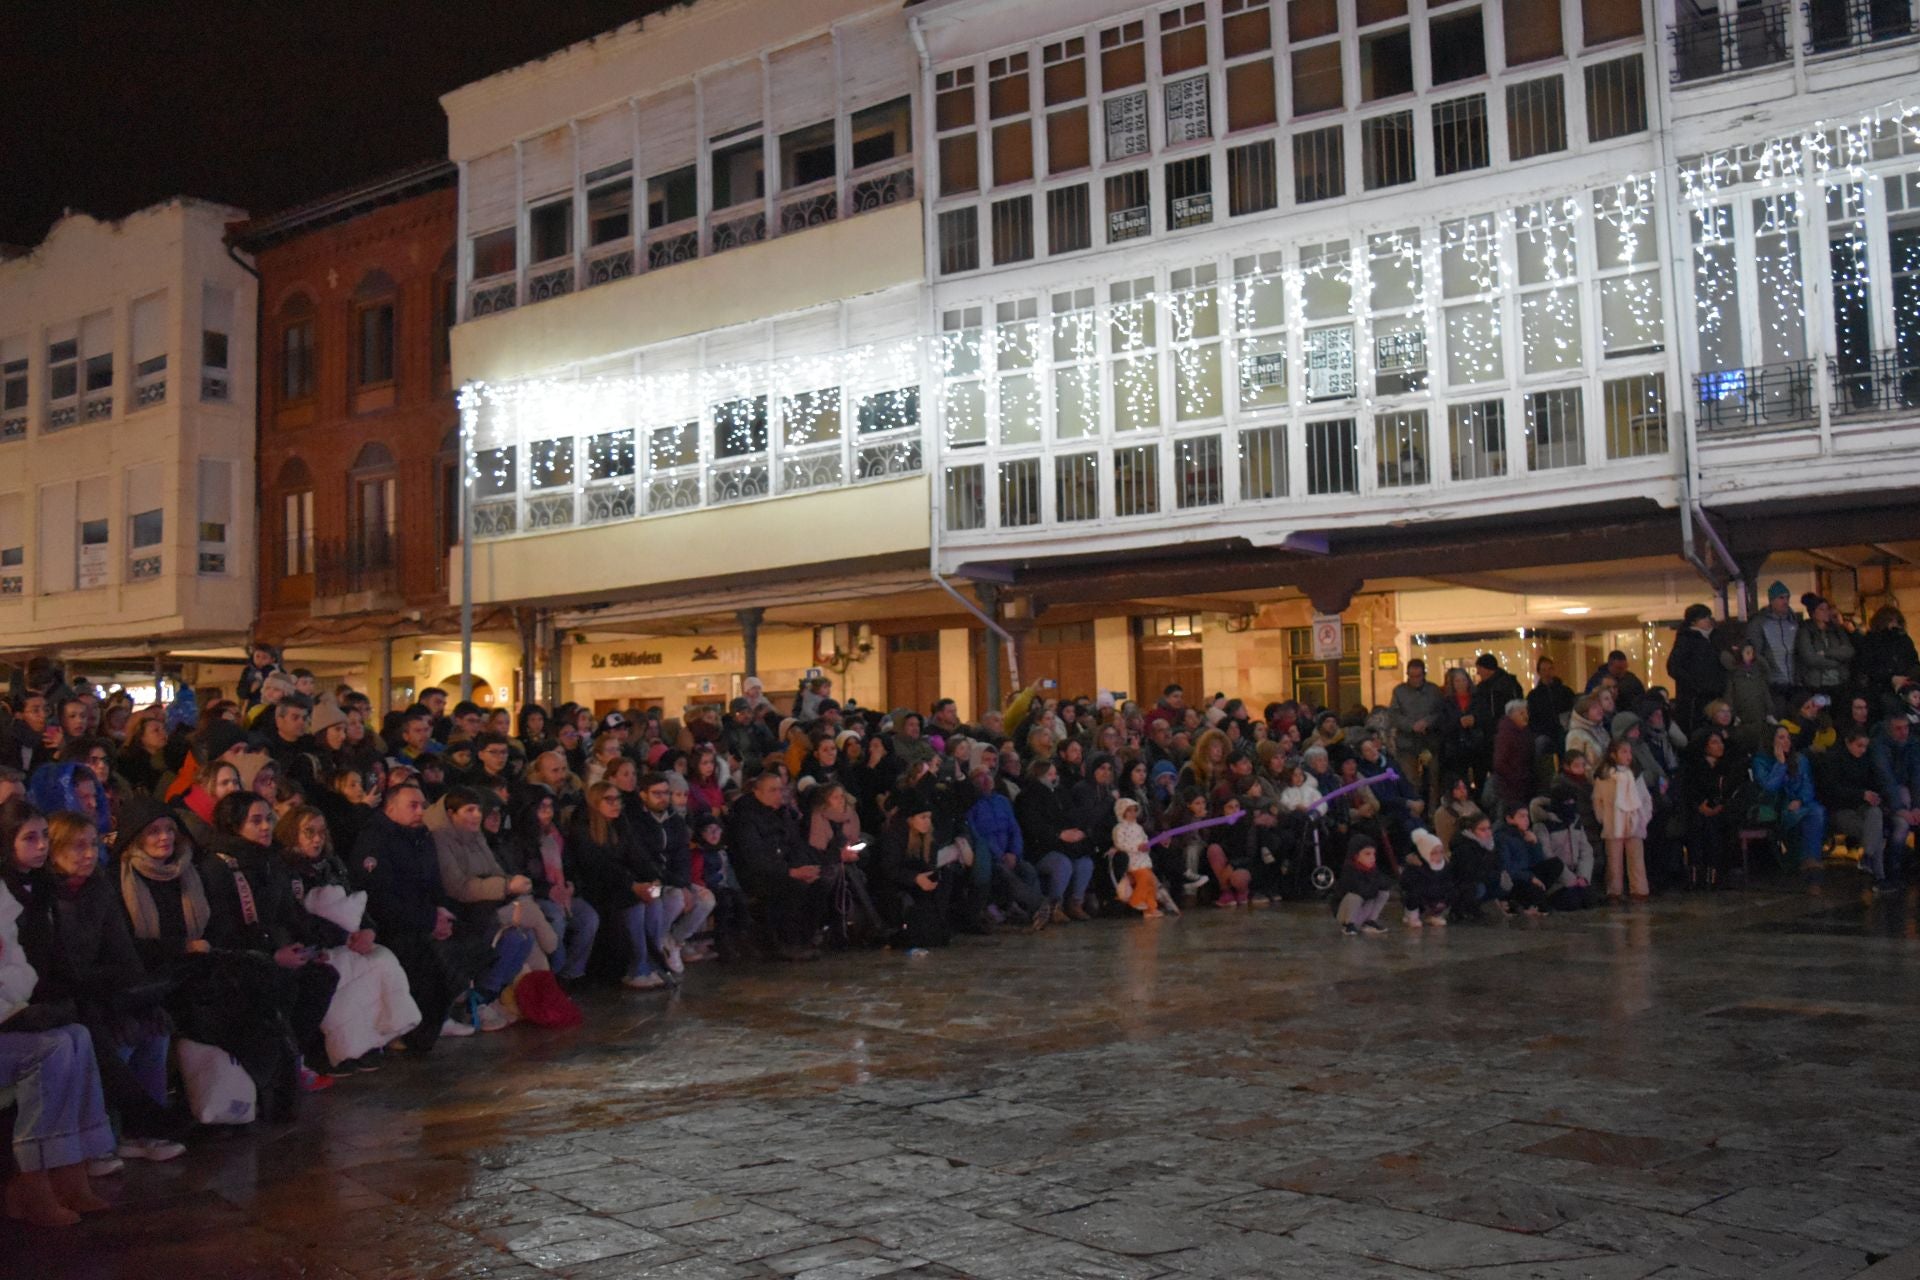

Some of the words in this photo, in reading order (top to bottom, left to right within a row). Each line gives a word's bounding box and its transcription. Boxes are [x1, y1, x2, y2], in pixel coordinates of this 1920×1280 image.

[1183, 81, 1193, 100] 992
[1194, 78, 1204, 96] 143
[1123, 96, 1133, 115] 992
[1134, 94, 1143, 111] 143
[1184, 101, 1194, 120] 493
[1195, 99, 1205, 117] 824
[1124, 116, 1134, 133] 493
[1135, 113, 1145, 131] 824
[1184, 122, 1196, 140] 623
[1125, 136, 1135, 154] 623
[1175, 199, 1189, 210] SE
[1175, 203, 1212, 219] VENDE
[1112, 213, 1125, 223] SE
[1112, 217, 1147, 232] VENDE
[1328, 329, 1338, 350] 992
[1380, 337, 1394, 347] SE
[1380, 342, 1420, 356] VENDE
[1328, 352, 1339, 371] 493
[1329, 374, 1340, 393] 623
[591, 653, 606, 668] La
[610, 650, 662, 667] Biblioteca
